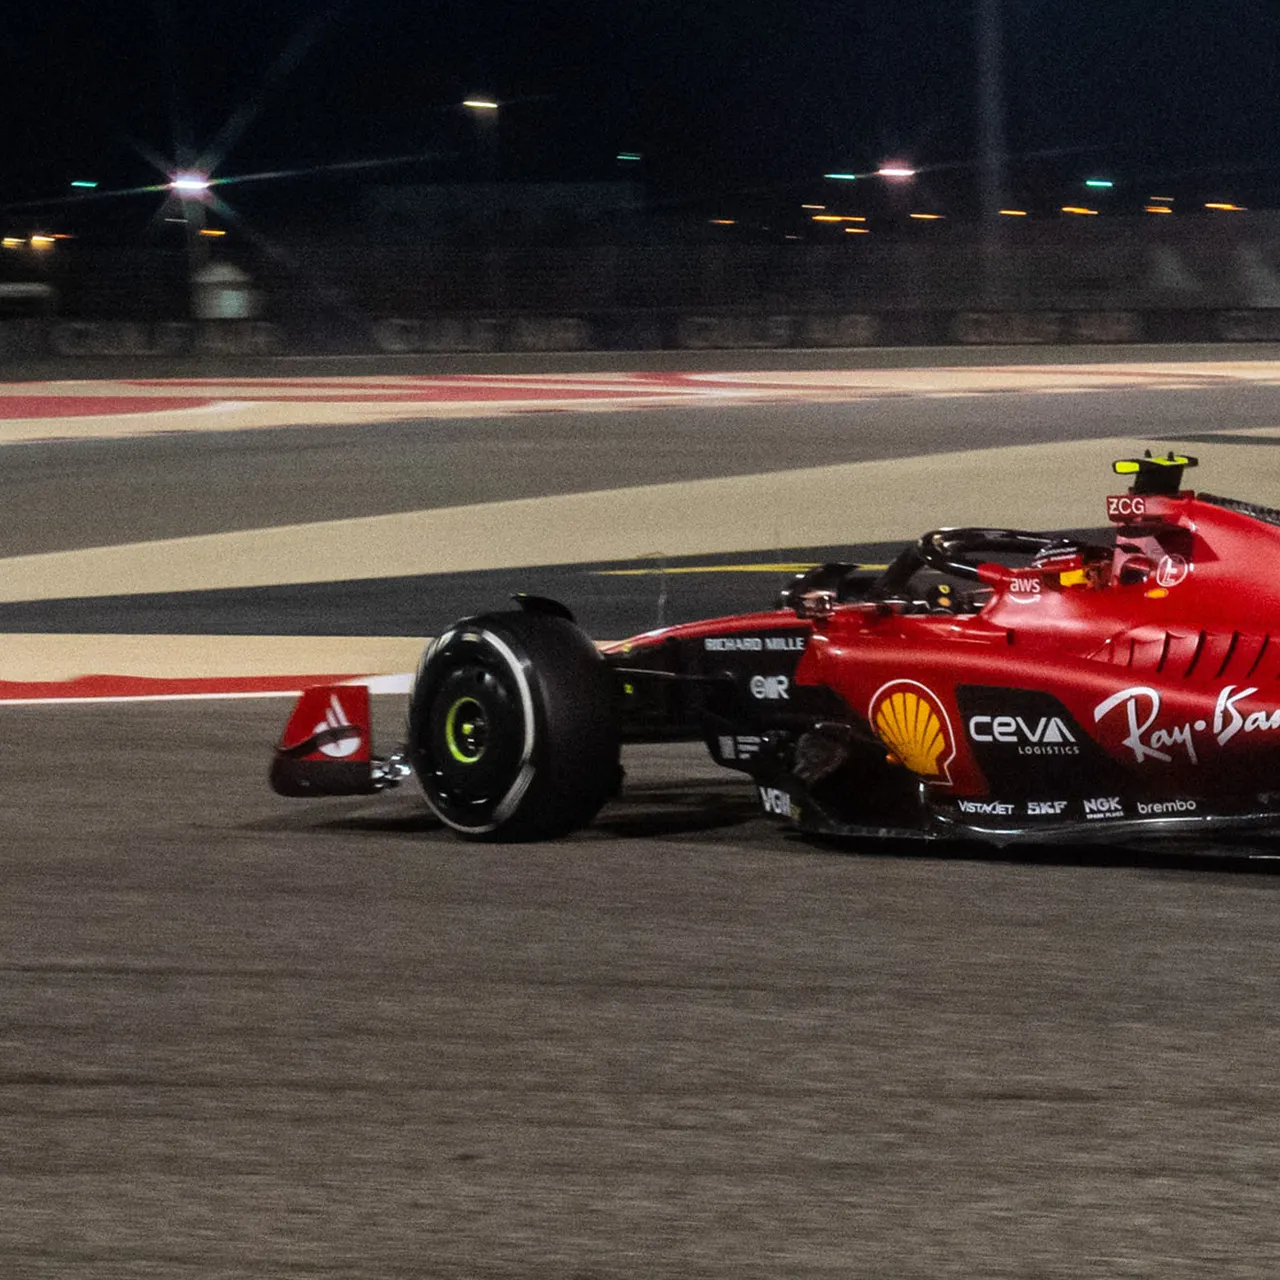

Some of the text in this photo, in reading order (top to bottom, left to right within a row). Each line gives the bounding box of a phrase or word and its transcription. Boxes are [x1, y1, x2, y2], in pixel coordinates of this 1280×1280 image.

[1108, 497, 1145, 515] ZCG
[1010, 578, 1040, 594] aws
[704, 637, 805, 651] RICHARD MILLE
[1018, 746, 1080, 755] LOGISTICS
[1027, 801, 1067, 815] SKF
[1083, 796, 1122, 813] NGK
[1137, 800, 1196, 814] brembo
